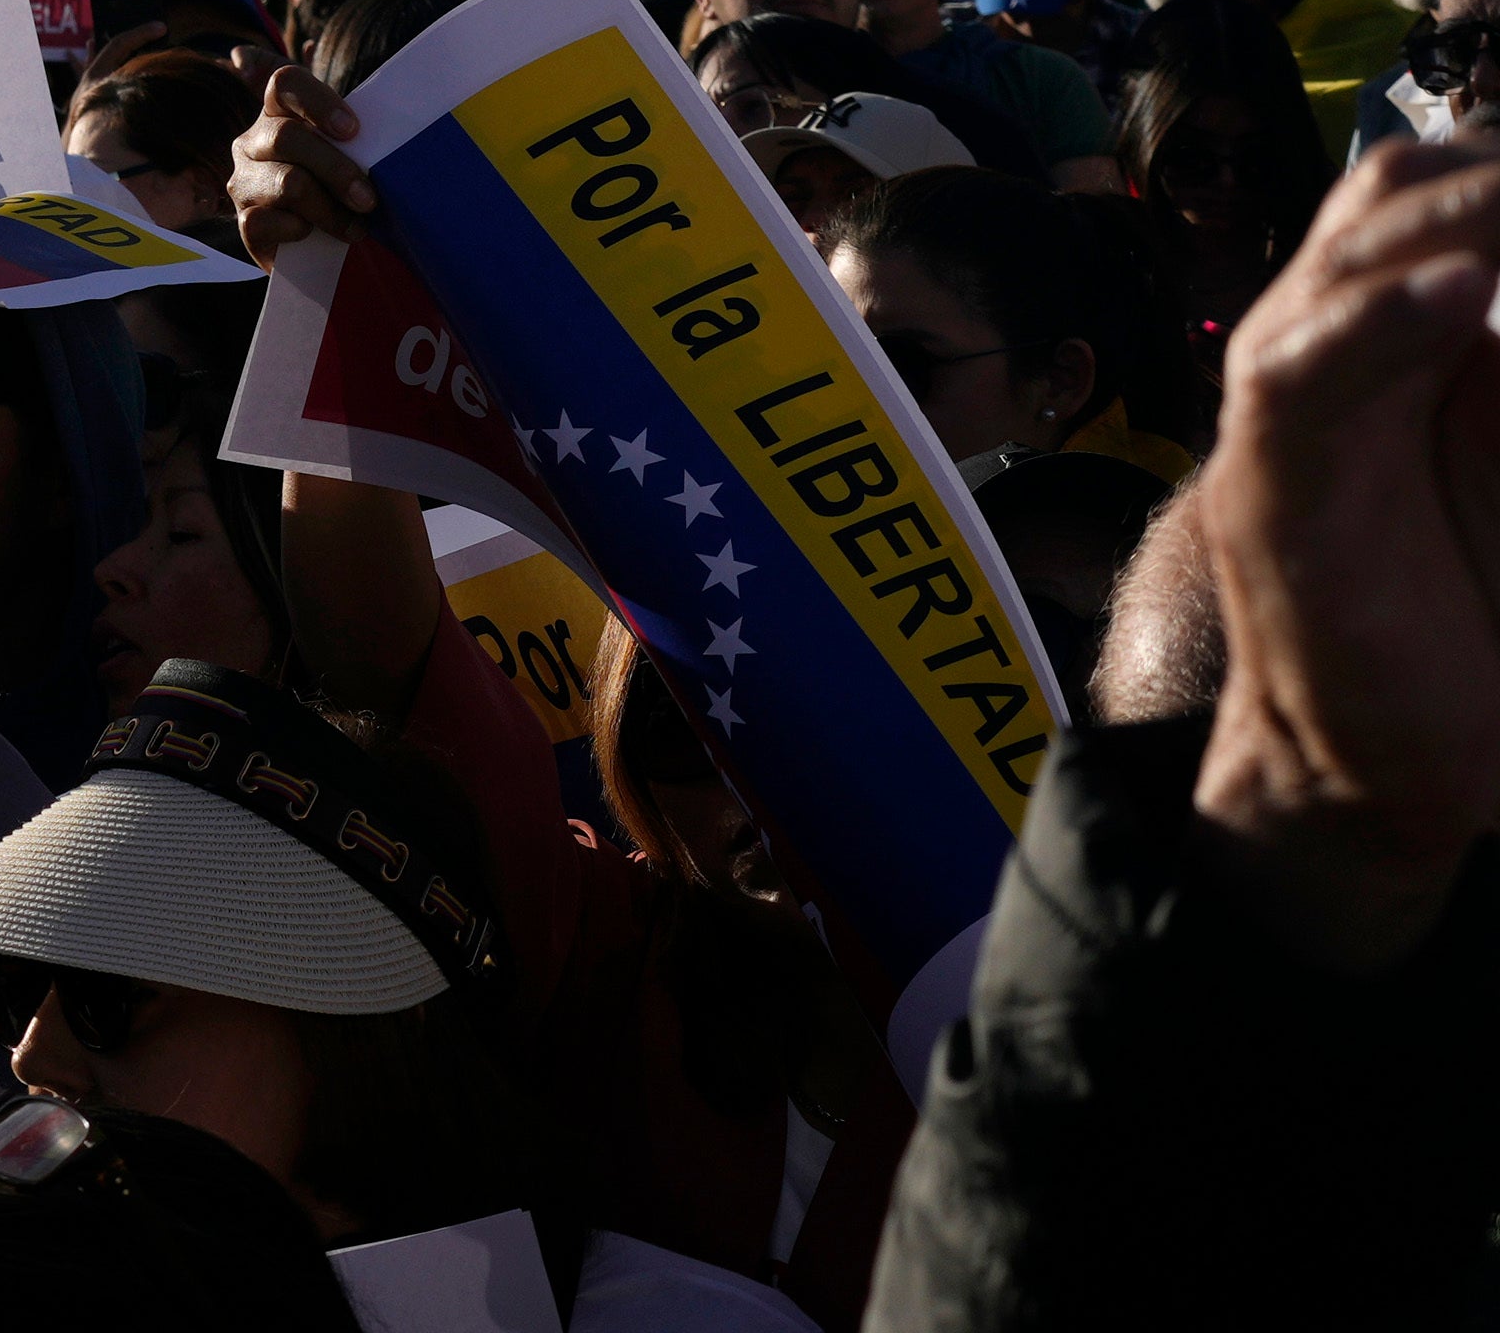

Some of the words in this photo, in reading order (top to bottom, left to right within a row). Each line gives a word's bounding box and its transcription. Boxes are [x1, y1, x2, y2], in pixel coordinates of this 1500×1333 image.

[394, 322, 490, 421] de
[526, 96, 692, 250] Por
[652, 262, 762, 362] la
[734, 370, 1049, 798] LIBERTAD
